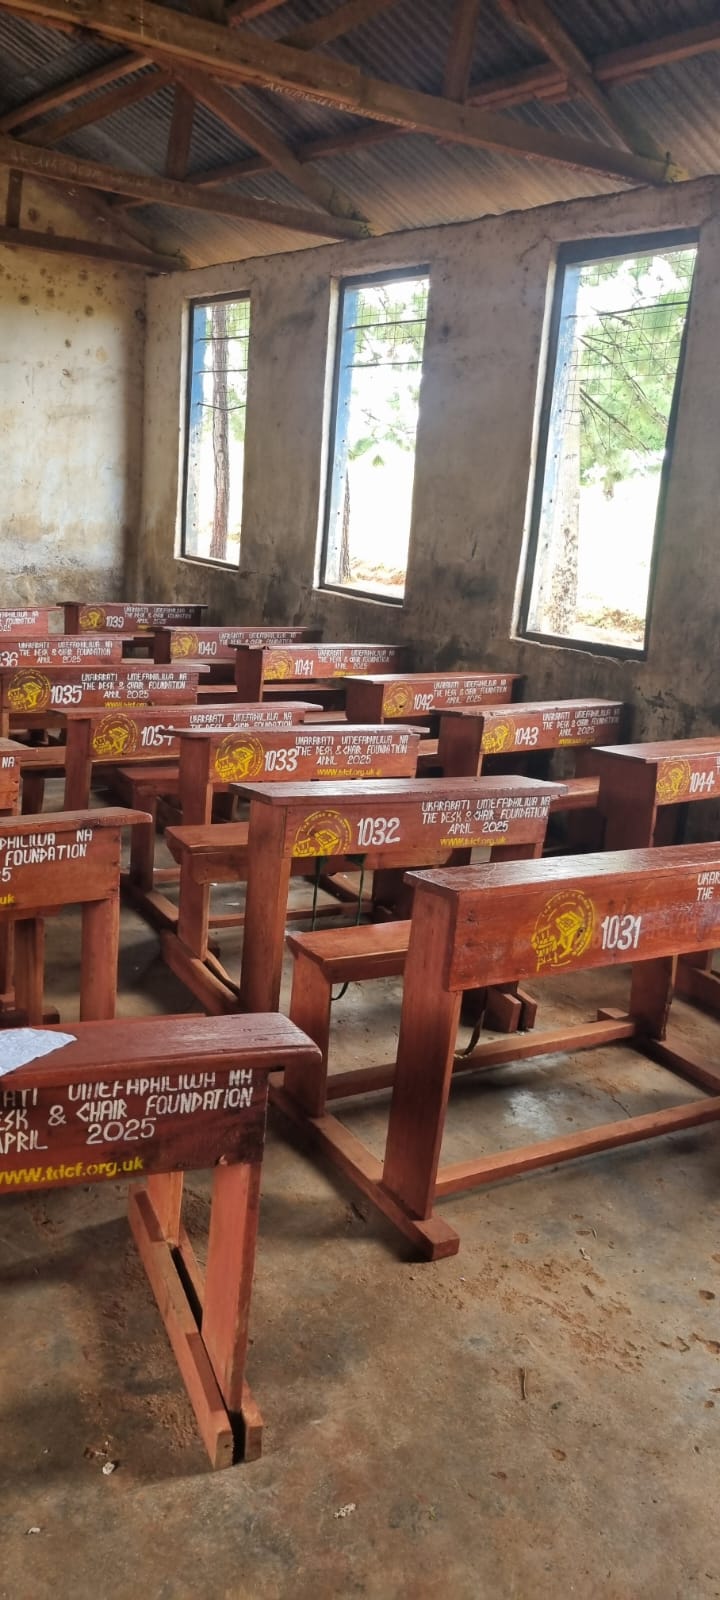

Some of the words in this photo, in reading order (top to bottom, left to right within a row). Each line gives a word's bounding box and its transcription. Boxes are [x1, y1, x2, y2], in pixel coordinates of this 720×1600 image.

[105, 616, 124, 628] 1039
[198, 641, 217, 655] 1040
[0, 650, 18, 667] 36
[295, 658, 314, 676] 1041
[51, 684, 82, 705] 1035
[127, 690, 149, 699] 2025
[414, 693, 434, 710] 1042
[514, 726, 539, 745] 1043
[2, 756, 15, 768] NA
[265, 749, 298, 772] 1033
[347, 754, 372, 765] 2025
[689, 771, 715, 793] 1044
[421, 799, 470, 812] UKARABATI
[422, 812, 438, 825] THE
[441, 811, 462, 824] DESK
[501, 806, 549, 820] FOUNDATION
[76, 828, 93, 843] NA
[357, 817, 400, 847] 1032
[447, 823, 473, 835] APRIL
[482, 820, 509, 834] 2025
[5, 843, 87, 867] FOUNDATION
[0, 867, 13, 882] 5
[696, 886, 714, 901] THE
[601, 914, 642, 951] 1031
[47, 1104, 67, 1126] &
[76, 1098, 128, 1122] CHAIR
[145, 1086, 254, 1116] FOUNDATION
[86, 1117, 157, 1145] 2025
